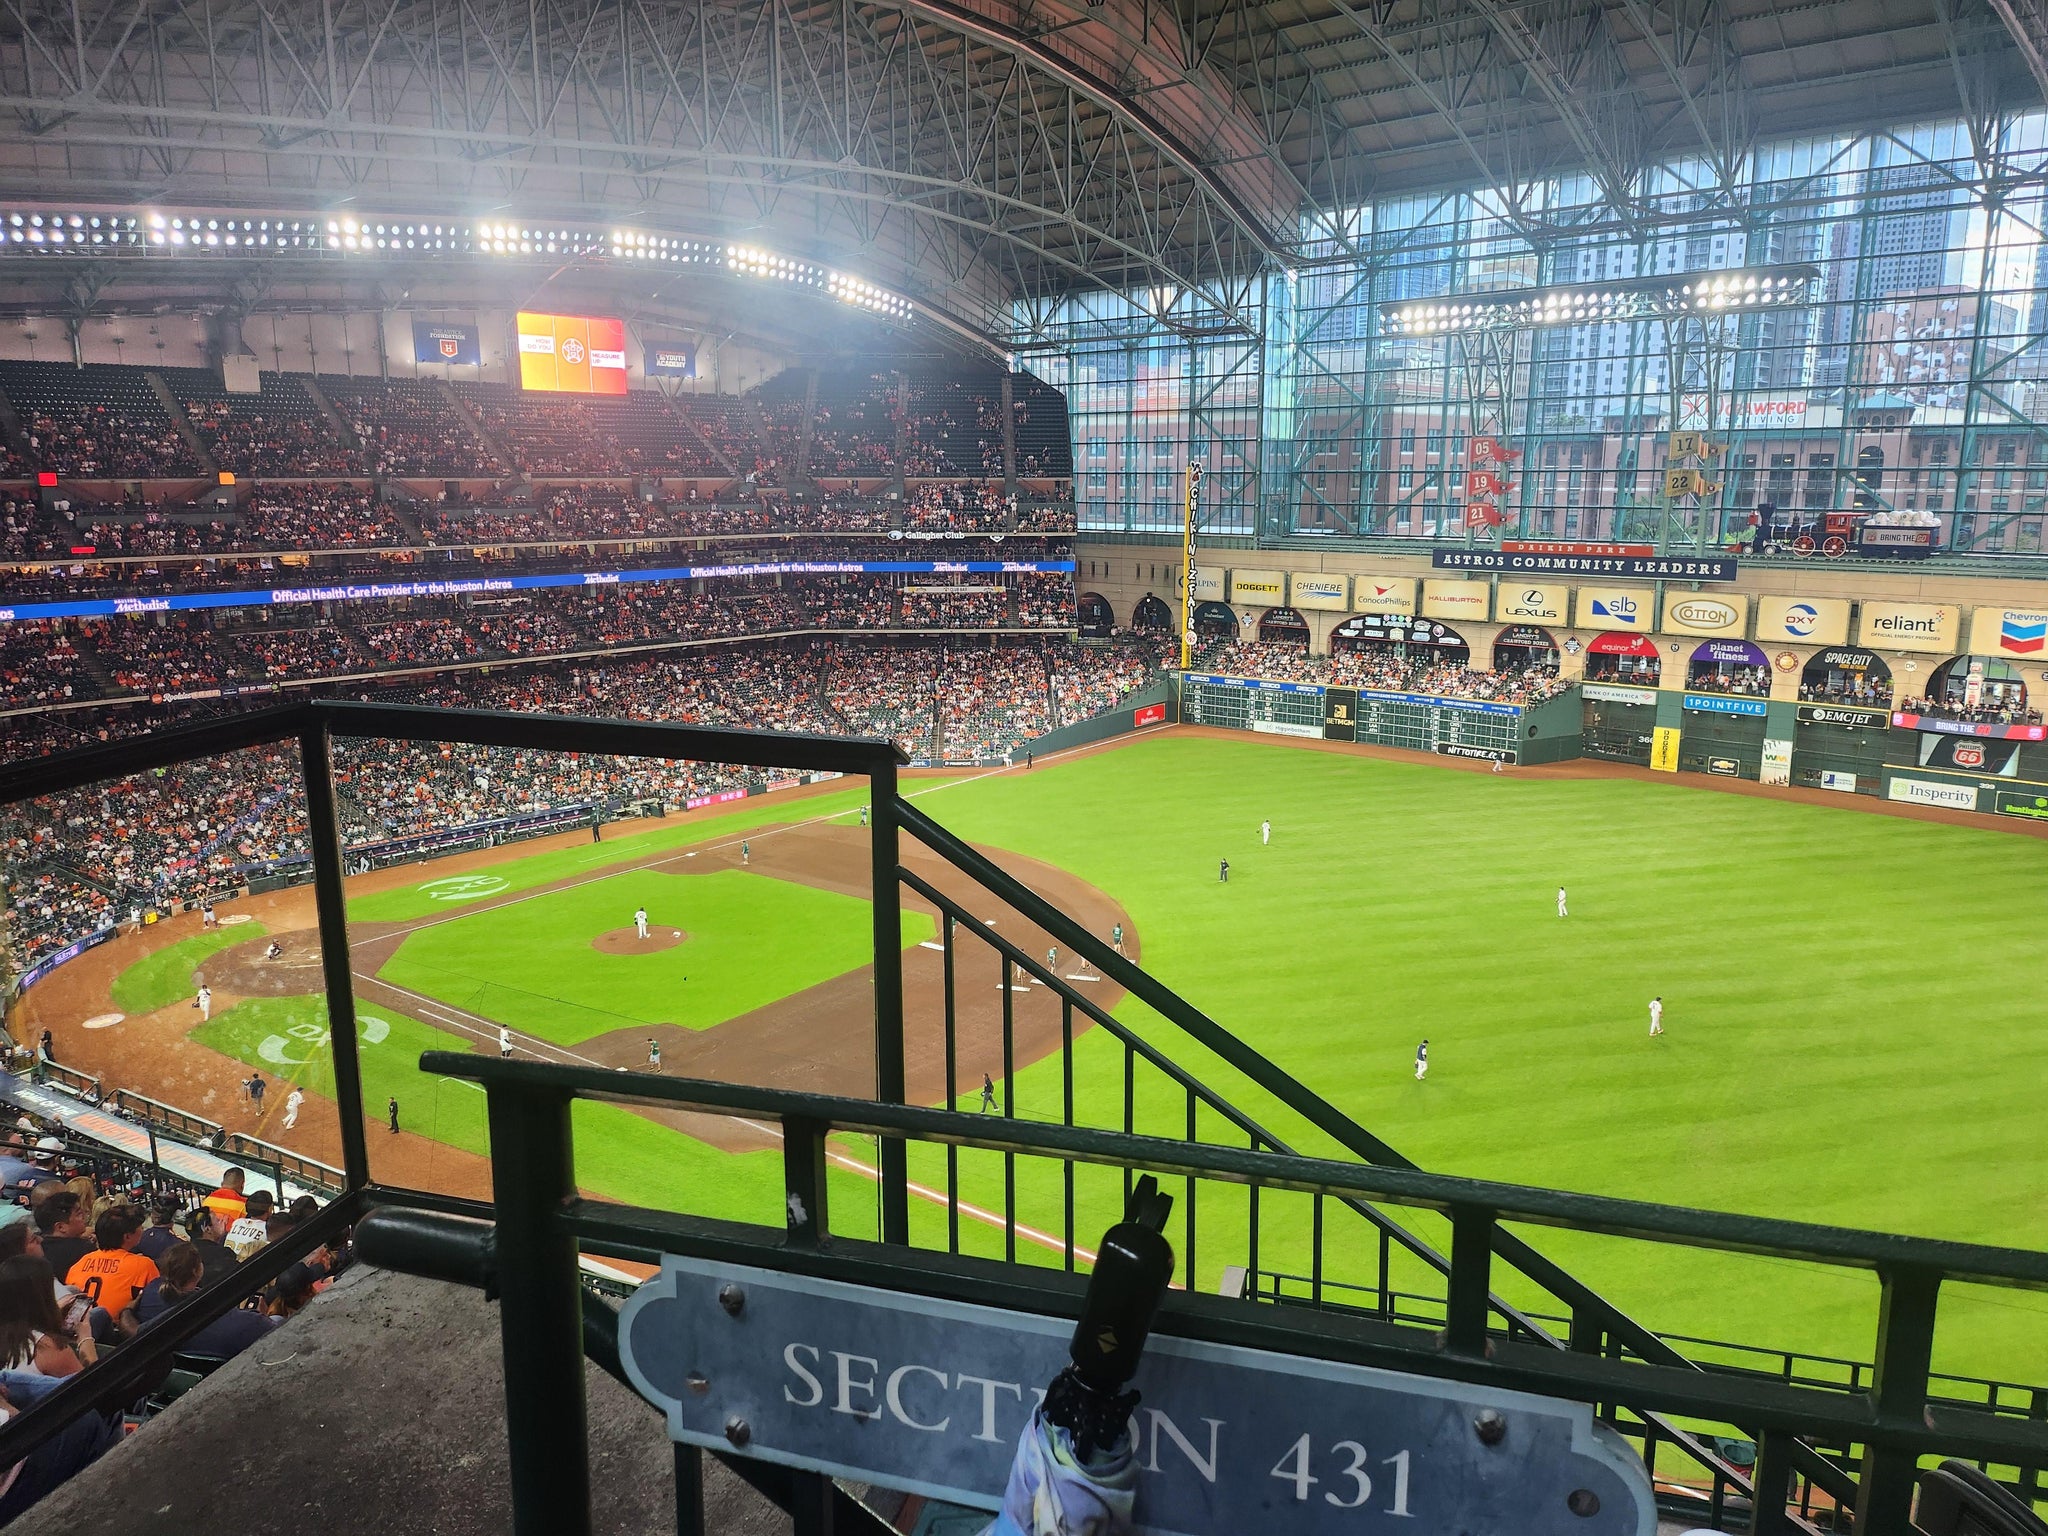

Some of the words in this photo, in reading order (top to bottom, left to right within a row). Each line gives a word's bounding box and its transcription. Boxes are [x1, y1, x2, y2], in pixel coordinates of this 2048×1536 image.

[1475, 441, 1489, 455] 05
[1677, 437, 1693, 451] 17
[1474, 476, 1487, 488] 19
[1672, 476, 1688, 489] 22
[1471, 507, 1484, 519] 21
[1187, 486, 1198, 557] CHIKIN
[1880, 534, 1900, 542] BRING
[1902, 534, 1916, 542] THE
[1586, 546, 1626, 554] PARK
[690, 566, 714, 578] Official
[716, 566, 738, 576] Health
[738, 565, 754, 574] Care
[754, 564, 780, 574] Provider
[781, 562, 790, 572] for
[792, 562, 804, 572] the
[805, 562, 837, 572] Houston
[838, 562, 863, 572] Astros
[1443, 554, 1504, 566] ASTROS
[1512, 557, 1624, 571] COMMUNITY
[1634, 561, 1721, 575] LEADERS
[1178, 575, 1220, 588] CLPINE
[1236, 582, 1279, 592] DOGGETT
[1296, 582, 1342, 592] CHENIERE
[272, 590, 310, 602] Official
[312, 588, 346, 600] Health
[347, 586, 370, 598] Care
[372, 584, 411, 596] Provider
[413, 584, 428, 594] for
[428, 582, 444, 592] the
[445, 582, 482, 592] Houston
[484, 580, 512, 590] Astros
[1358, 596, 1411, 607] ConocoPhillips
[1428, 595, 1483, 604] HALLIBURTON
[1610, 596, 1636, 613] slb
[116, 600, 170, 613] Methodist
[1186, 583, 1196, 631] FAIR
[1505, 608, 1557, 618] LEXUS
[1679, 606, 1728, 624] COTTON
[1786, 616, 1816, 625] OXY
[2004, 611, 2048, 622] Chevron
[1874, 616, 1936, 632] reliant
[1602, 644, 1629, 652] equinor
[1710, 643, 1744, 652] planet
[1712, 650, 1749, 662] fitness
[1824, 652, 1850, 664] SPACE
[1850, 654, 1873, 666] CITY
[1690, 698, 1762, 712] 1POINTFIVE
[1326, 718, 1354, 727] BETMGM
[1826, 711, 1872, 724] EMCJET
[1936, 721, 1958, 732] BRING
[1960, 724, 1975, 733] THE
[1976, 726, 1992, 735] GO
[1662, 730, 1670, 766] DOGGETT
[1958, 752, 1979, 762] 66
[1910, 784, 1974, 805] Insperity
[231, 1224, 264, 1240] LTUVE
[82, 1258, 120, 1274] DAVIDS
[783, 1342, 1227, 1483] SECTN
[1270, 1432, 1417, 1519] 431
